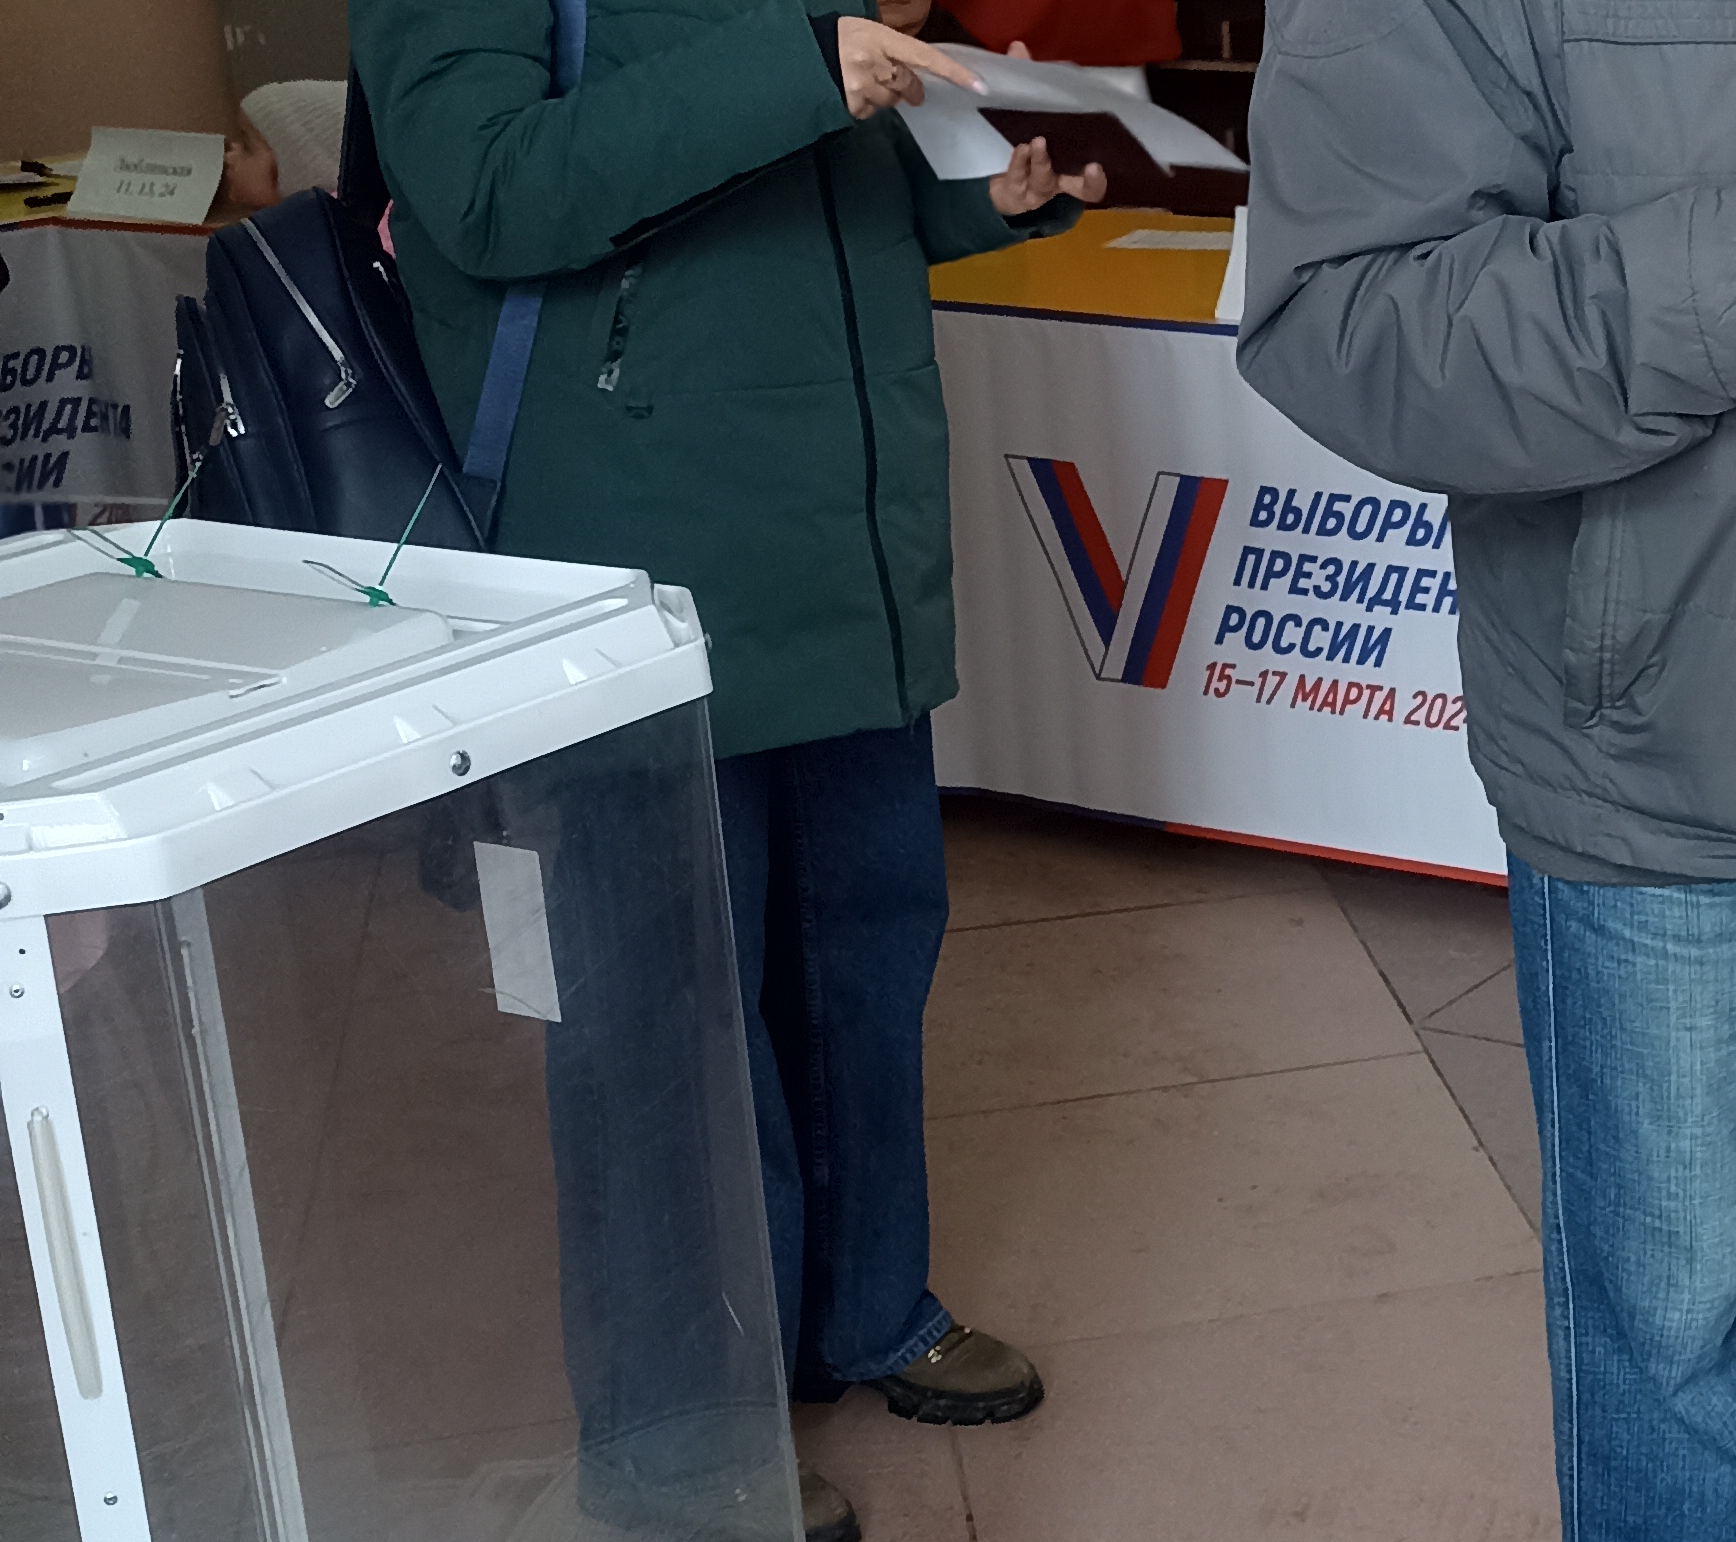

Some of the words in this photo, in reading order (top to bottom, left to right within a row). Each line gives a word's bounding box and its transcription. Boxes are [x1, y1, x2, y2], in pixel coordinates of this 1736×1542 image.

[0, 396, 132, 447] ЗИДЕНТА
[1249, 485, 1449, 550] ВЫБОРЫ
[1232, 545, 1459, 616] ПРЕЗИДЕН
[1213, 604, 1393, 669] РОССИИ
[1290, 674, 1397, 723] МАРТА
[1403, 690, 1467, 732] 202
